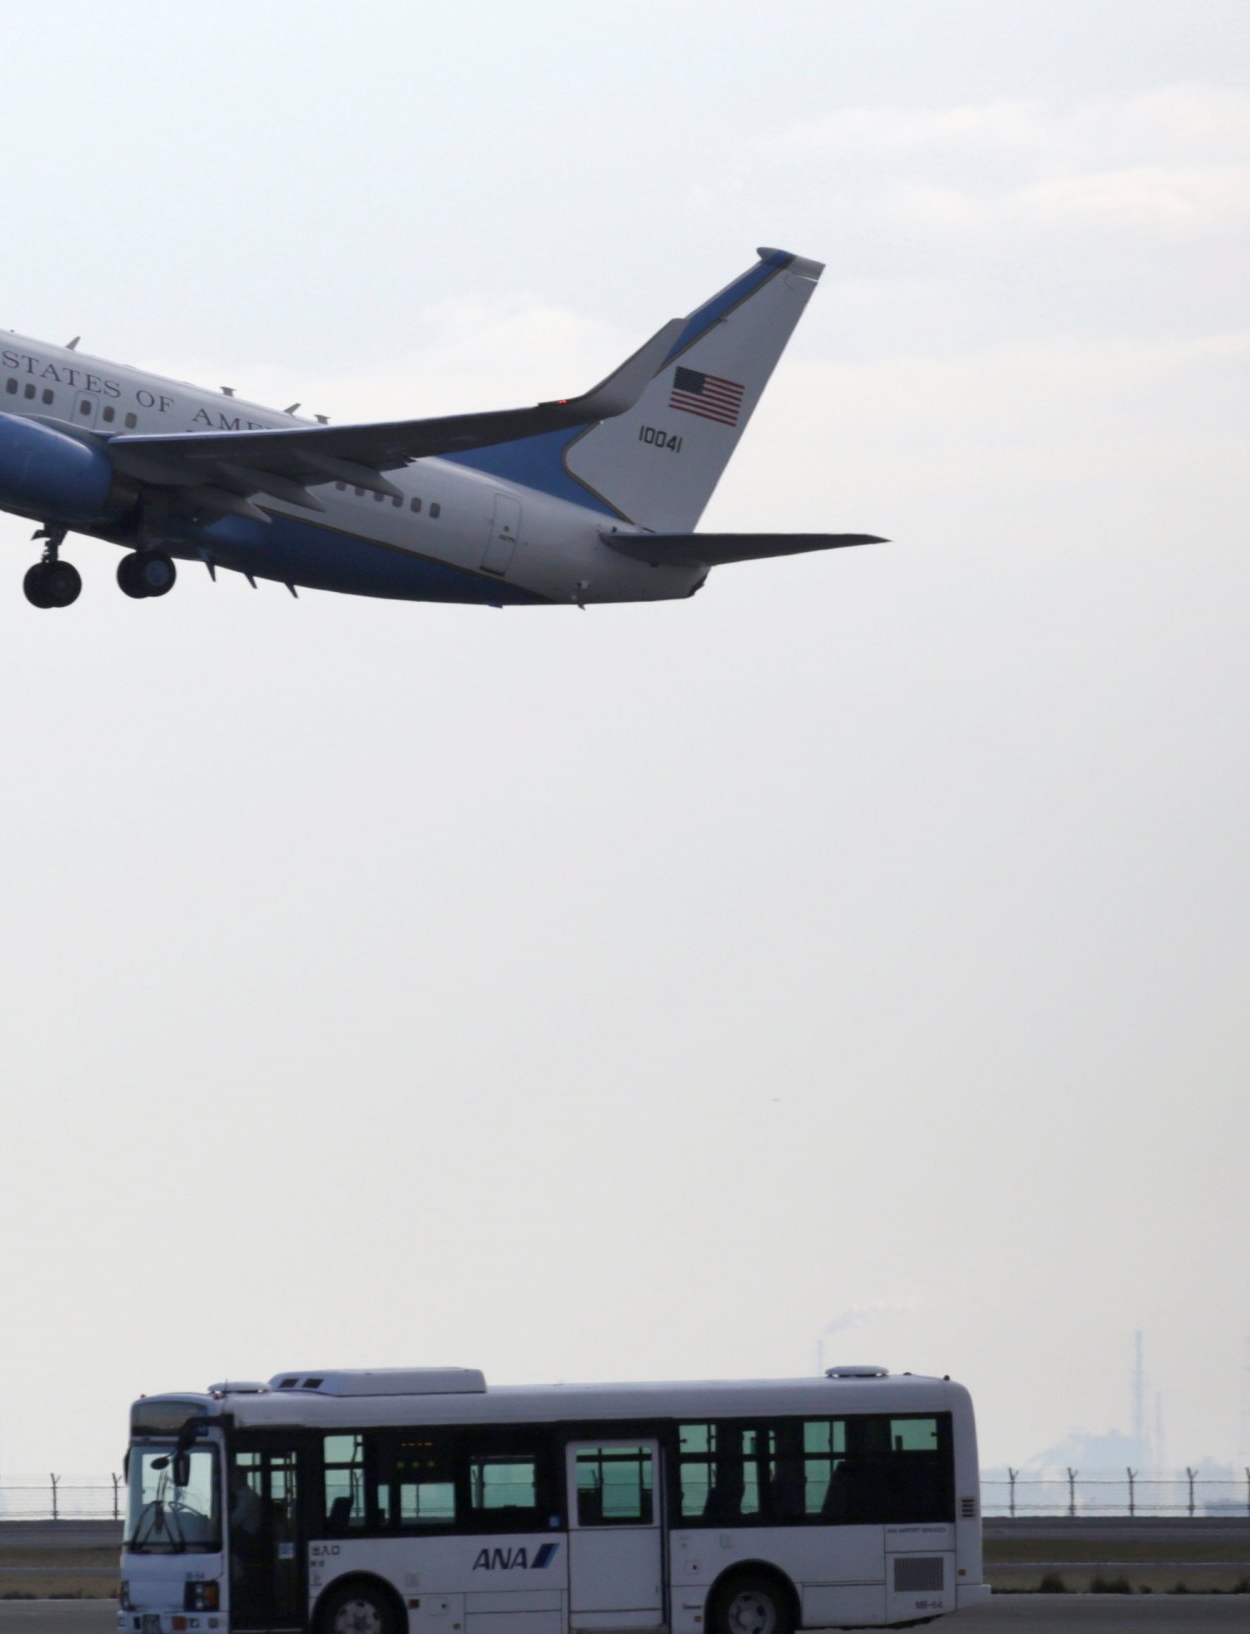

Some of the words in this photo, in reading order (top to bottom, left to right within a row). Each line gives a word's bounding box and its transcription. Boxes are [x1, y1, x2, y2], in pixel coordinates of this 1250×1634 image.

[1, 350, 123, 399] STATES
[135, 390, 175, 413] OF
[639, 425, 683, 454] 10041
[472, 1547, 528, 1570] ANA
